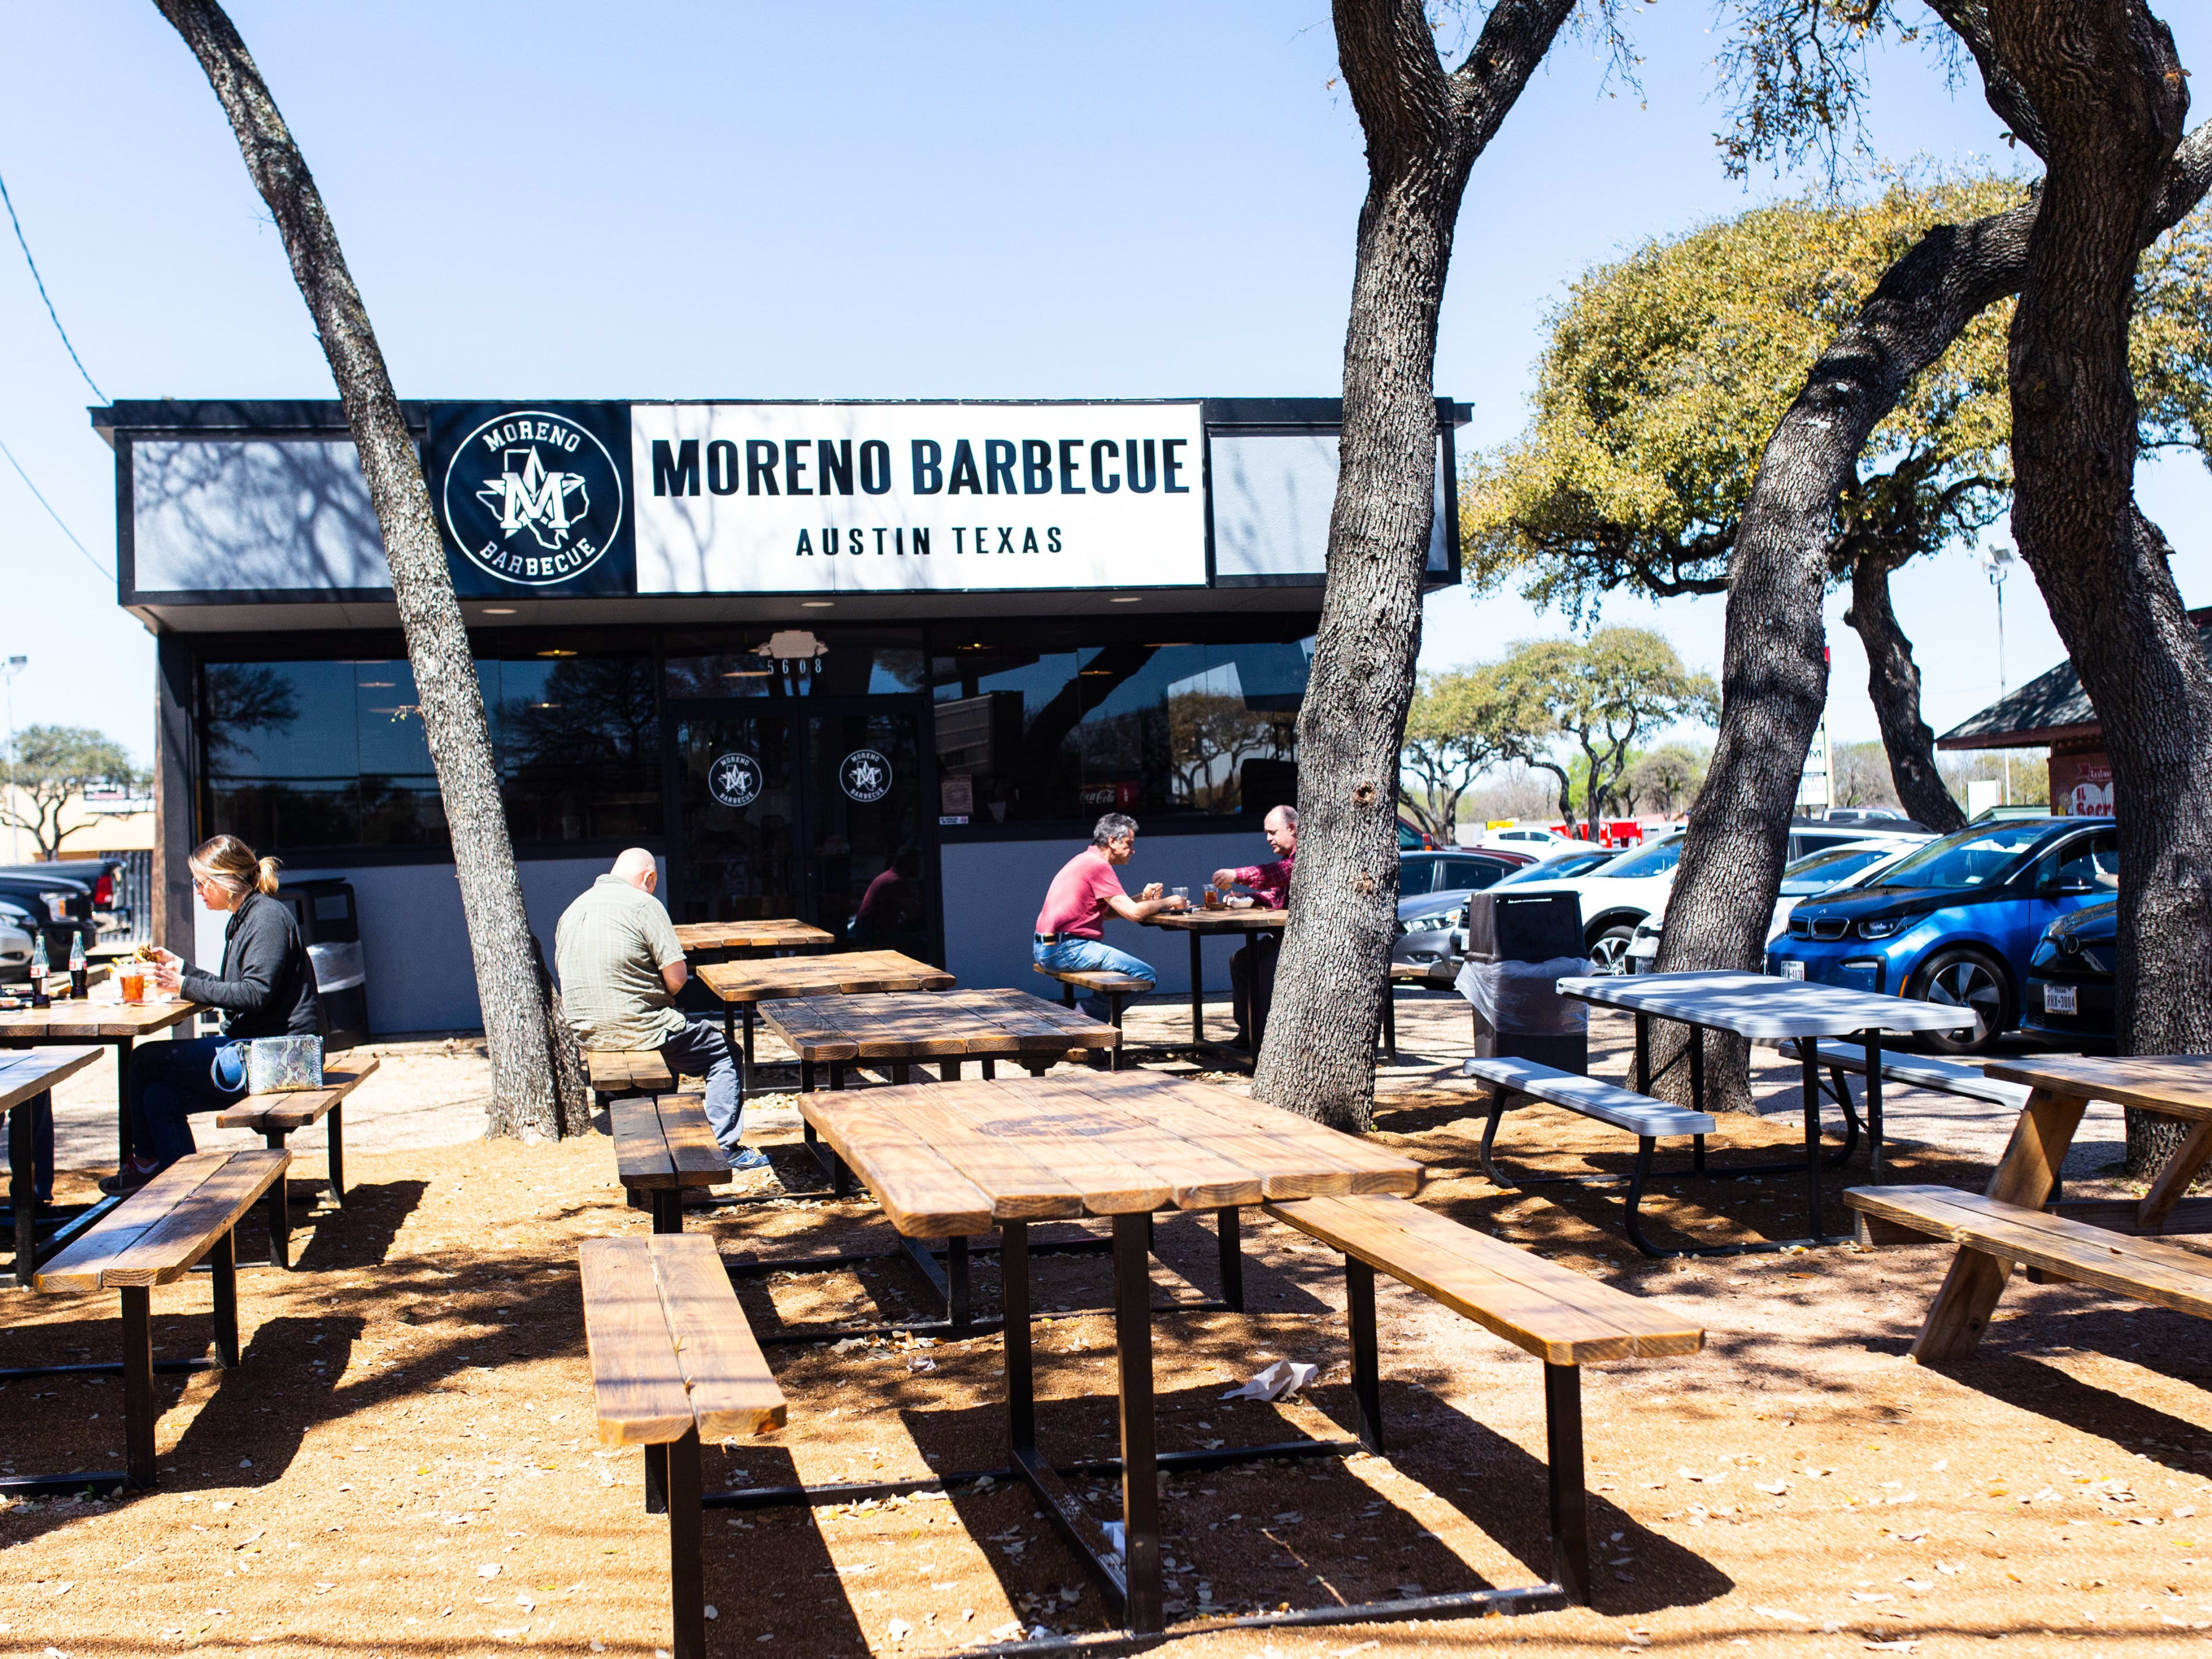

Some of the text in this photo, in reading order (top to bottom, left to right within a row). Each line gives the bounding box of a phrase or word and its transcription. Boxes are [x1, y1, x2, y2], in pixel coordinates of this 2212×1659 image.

[482, 421, 581, 452] MORENO
[652, 438, 1190, 497] MORENO BARBECUE
[500, 472, 570, 529] M
[796, 526, 1063, 556] AUSTIN TEXAS
[479, 537, 596, 576] BARBECUE
[767, 658, 822, 675] 5608
[720, 756, 749, 767] MORENO
[851, 752, 880, 762] MORENO
[719, 791, 754, 804] BARBECUE
[850, 787, 884, 799] BARBECUE
[2054, 986, 2066, 994] TEXAS
